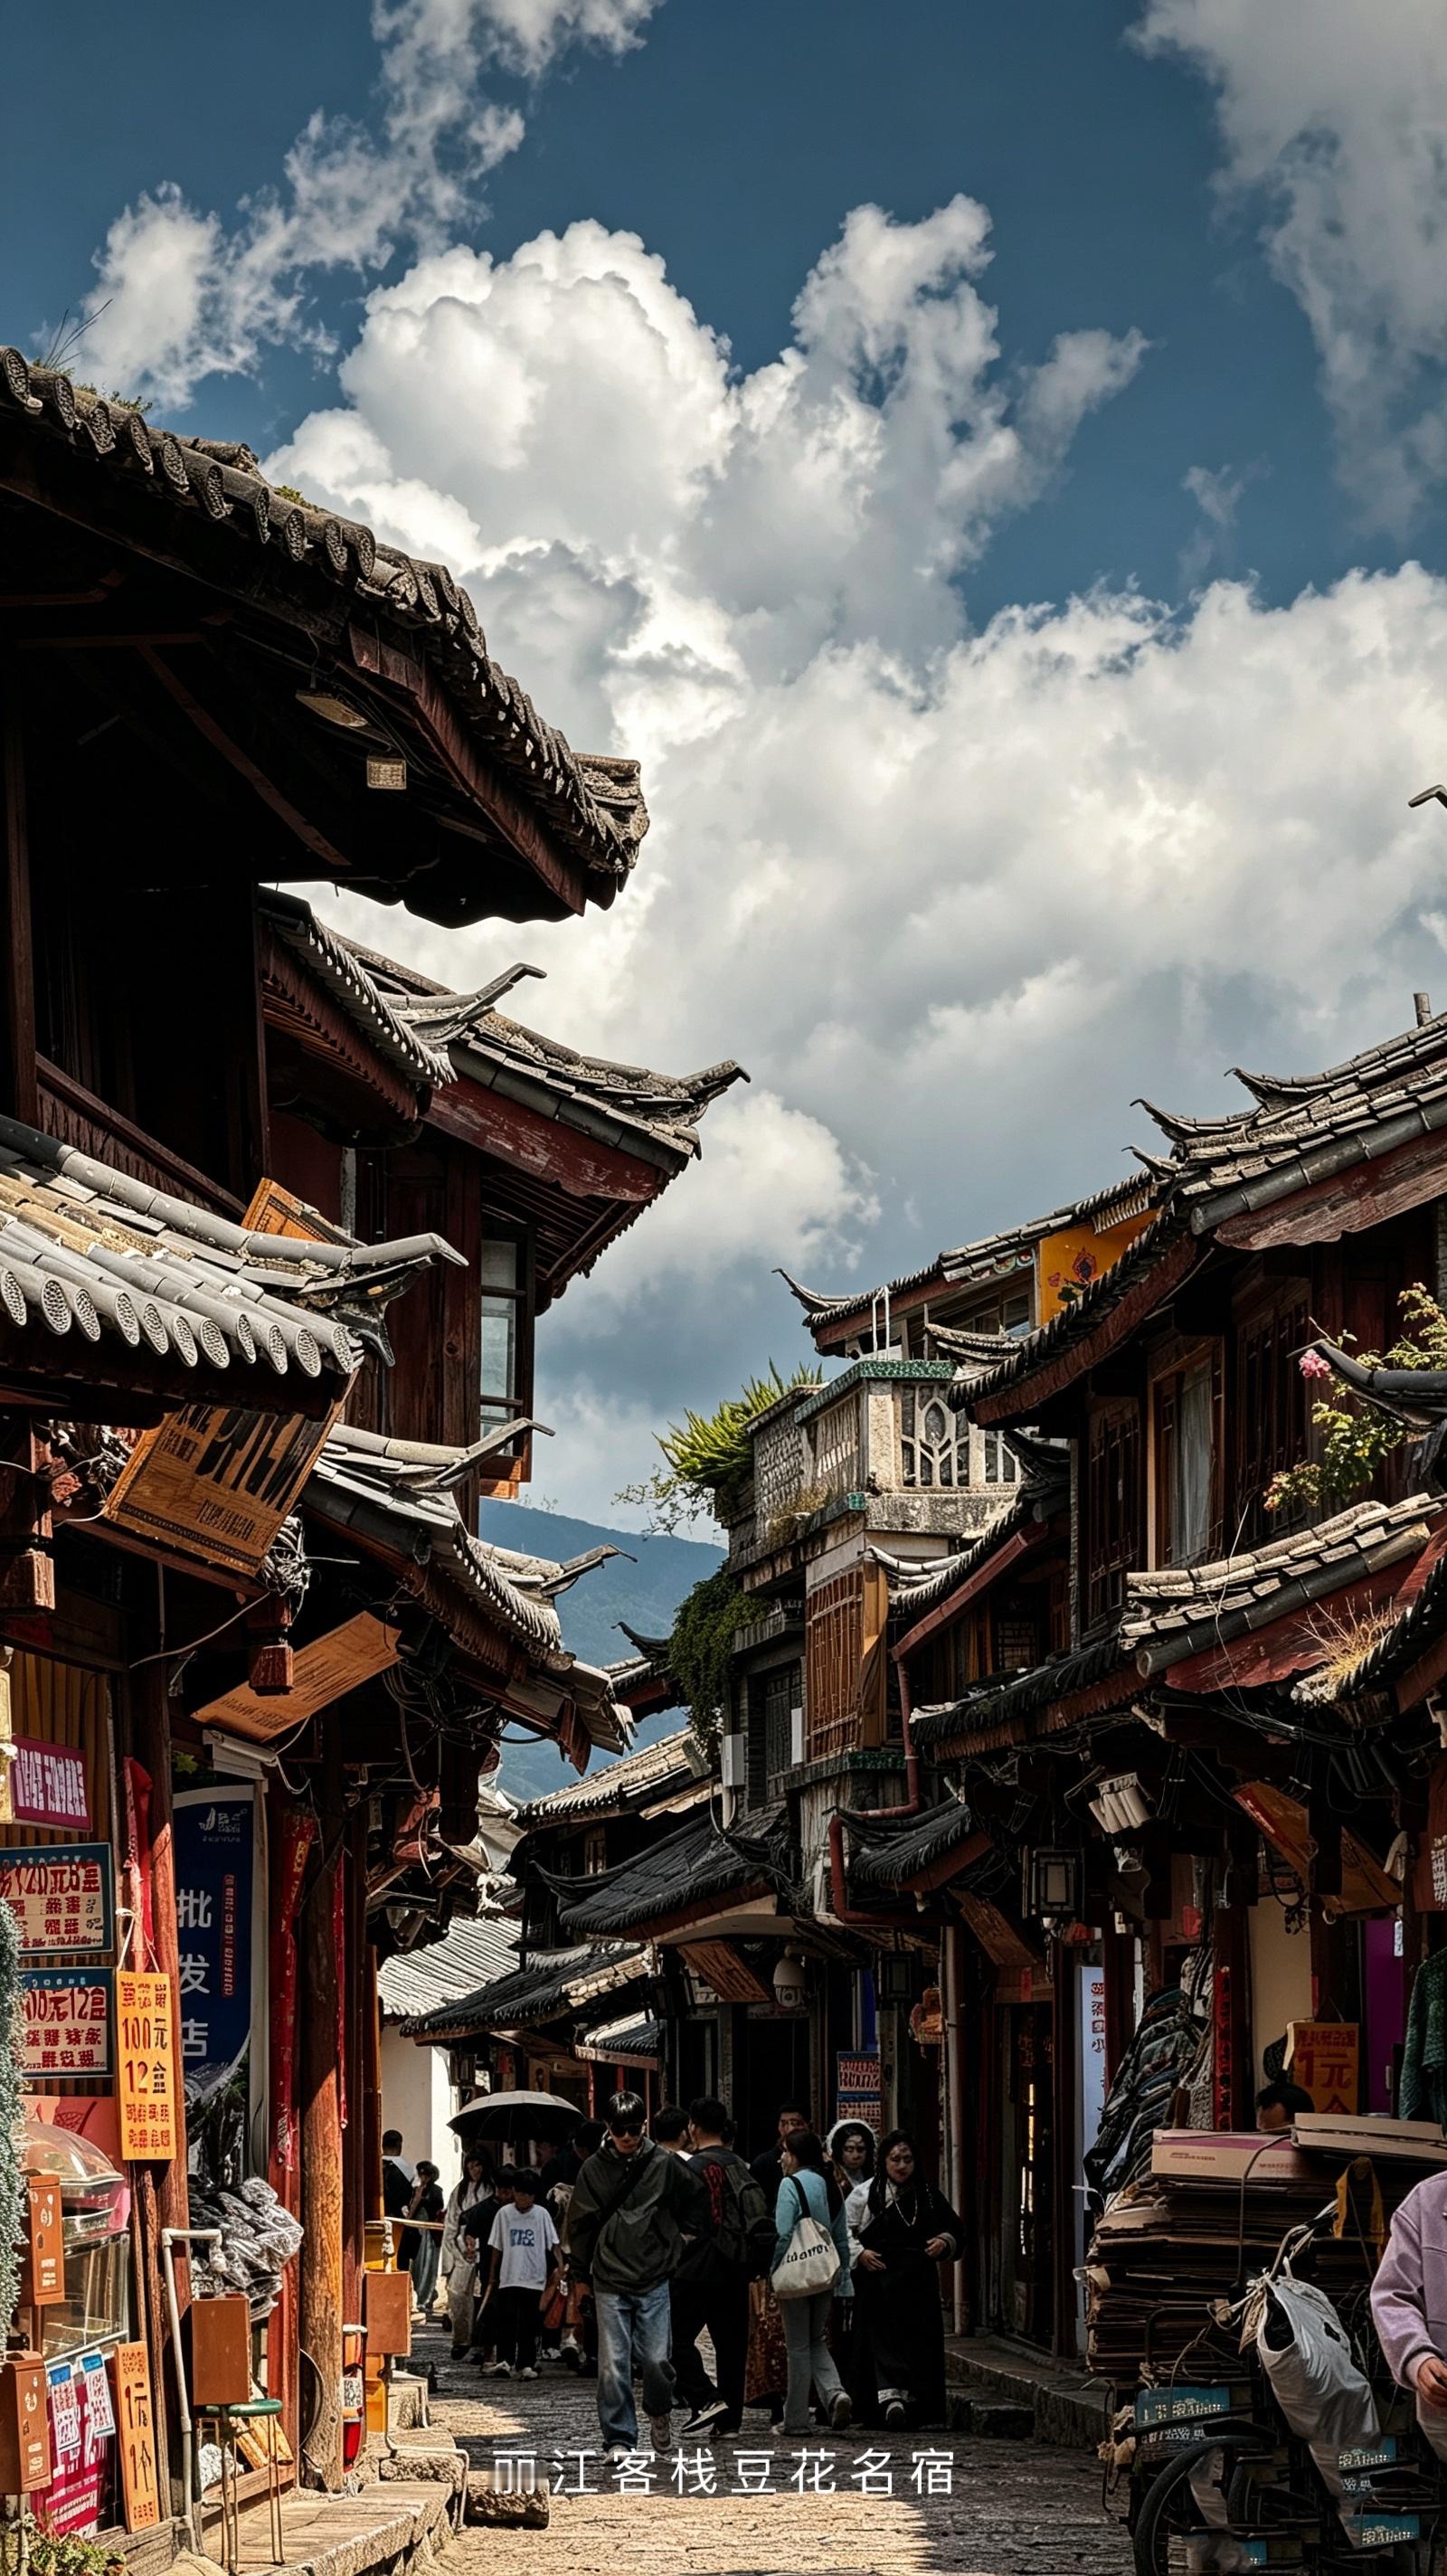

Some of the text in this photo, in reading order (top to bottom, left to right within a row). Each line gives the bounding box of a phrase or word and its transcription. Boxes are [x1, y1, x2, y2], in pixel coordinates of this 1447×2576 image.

[176, 1889, 213, 2057] 批发店
[1299, 2050, 1354, 2089] 1元
